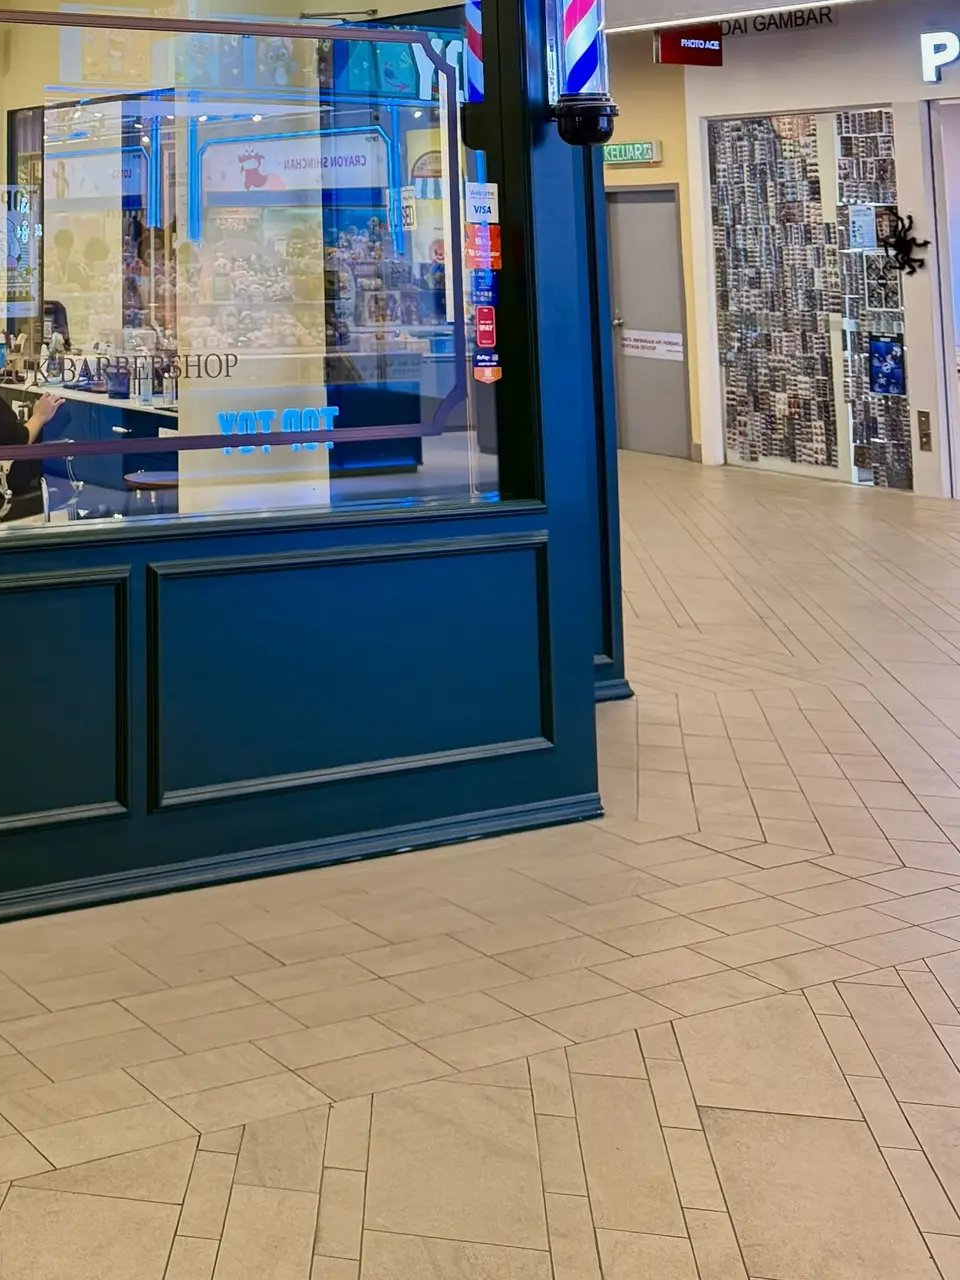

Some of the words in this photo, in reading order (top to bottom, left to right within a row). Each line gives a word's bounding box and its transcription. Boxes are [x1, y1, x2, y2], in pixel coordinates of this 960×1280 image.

[721, 21, 748, 36] DAI
[753, 6, 833, 32] GAMBAR
[680, 38, 705, 49] PHOTO
[705, 40, 720, 50] ACE
[603, 144, 643, 161] KELUAR
[469, 189, 495, 197] Welcome
[473, 205, 492, 214] VISA
[60, 353, 239, 383] BARBERSHOP
